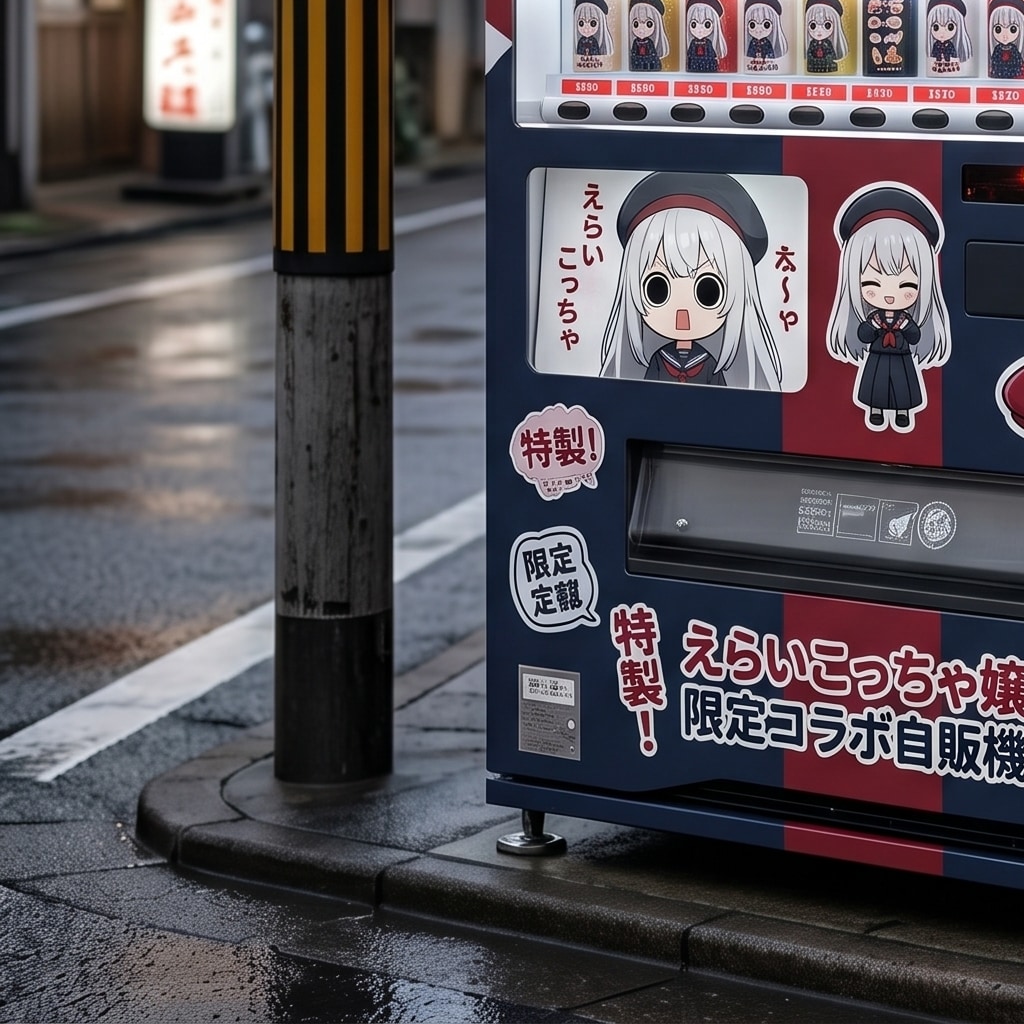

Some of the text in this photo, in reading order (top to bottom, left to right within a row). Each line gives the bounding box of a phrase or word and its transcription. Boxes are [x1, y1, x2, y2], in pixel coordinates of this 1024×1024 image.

[582, 183, 604, 266] えらい
[557, 246, 580, 350] こっちゃ
[520, 426, 598, 470] 特製!
[522, 542, 577, 582] 限定
